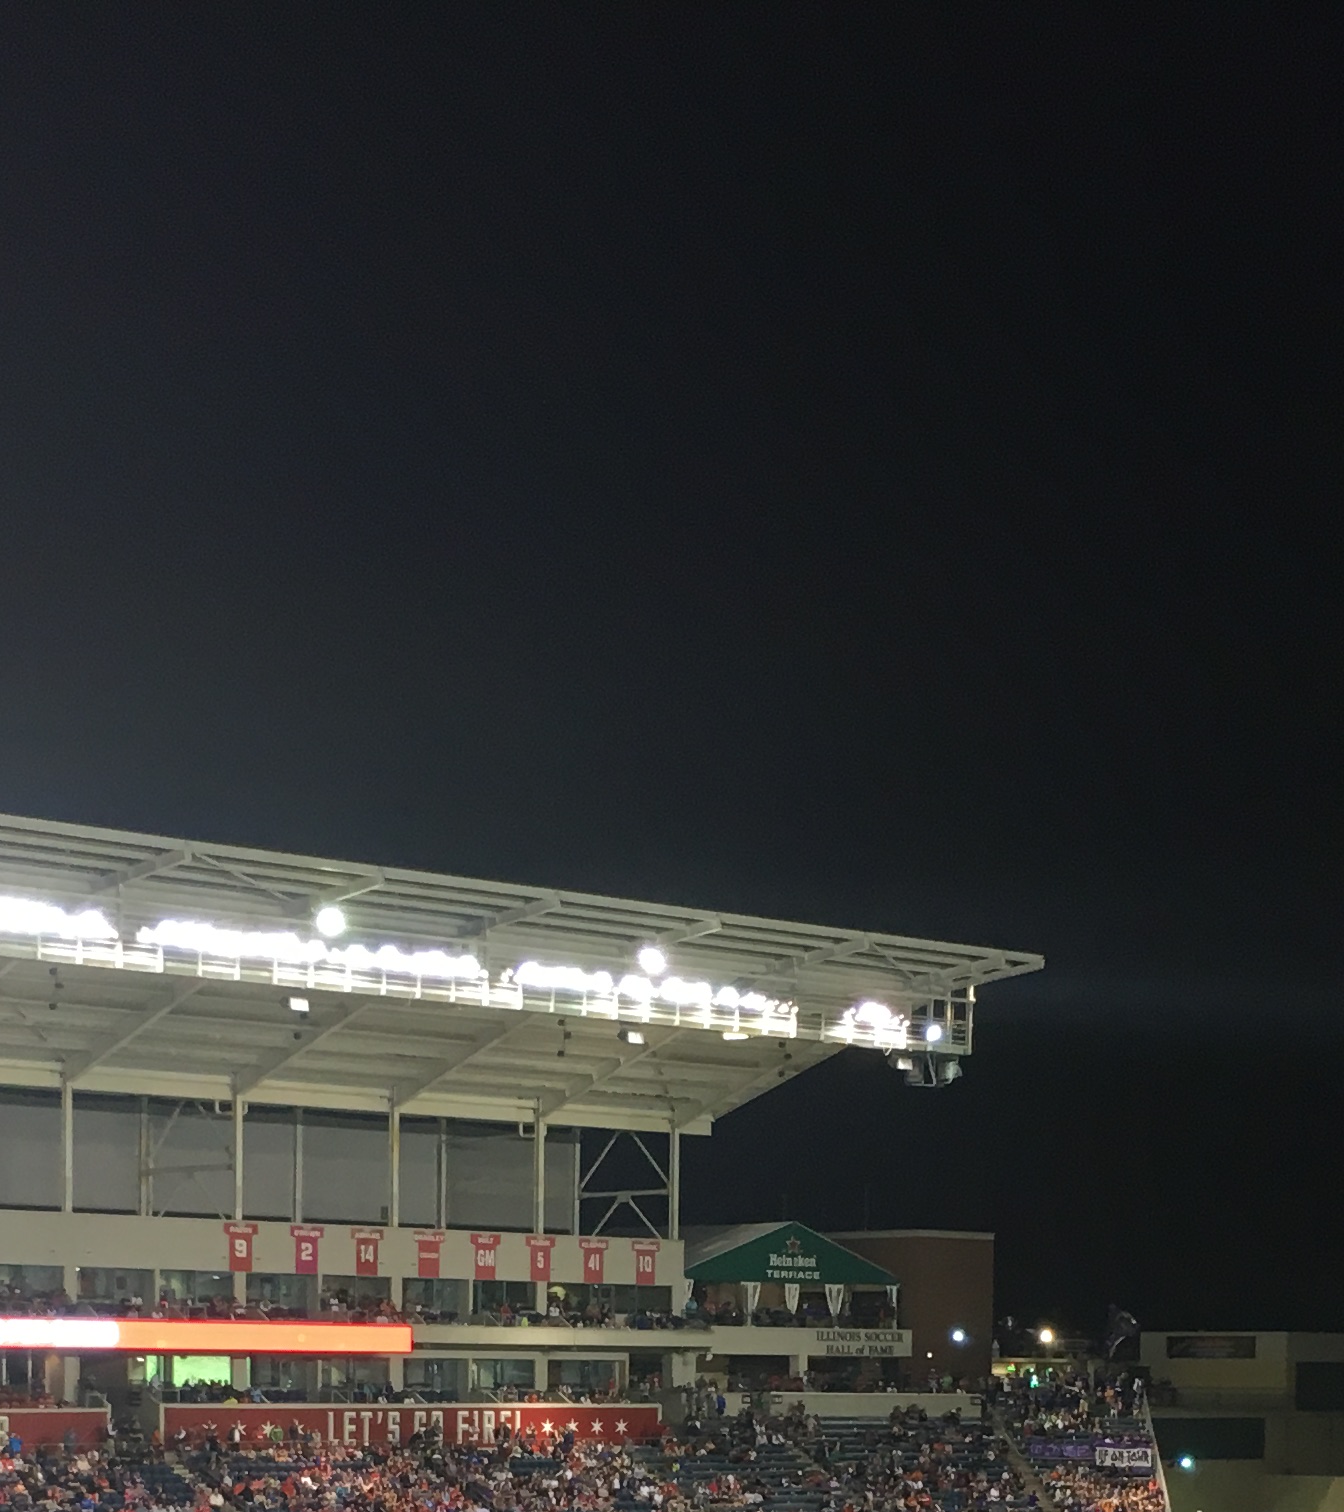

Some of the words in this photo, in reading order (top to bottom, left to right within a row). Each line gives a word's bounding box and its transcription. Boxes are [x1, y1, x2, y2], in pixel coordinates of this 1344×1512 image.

[235, 1239, 247, 1257] 9
[301, 1243, 313, 1260] 2
[360, 1245, 374, 1262] 14
[477, 1250, 495, 1267] GM
[537, 1252, 544, 1268] 5
[588, 1254, 600, 1270] 41
[639, 1256, 651, 1272] 10
[769, 1253, 817, 1267] Heineken
[766, 1269, 820, 1280] TERRACE
[816, 1331, 861, 1341] ILLINOIS
[864, 1332, 903, 1342] SOCCER
[826, 1345, 853, 1355] HALL
[855, 1345, 865, 1355] of
[868, 1345, 894, 1356] FAME
[328, 1411, 400, 1447] LET'S
